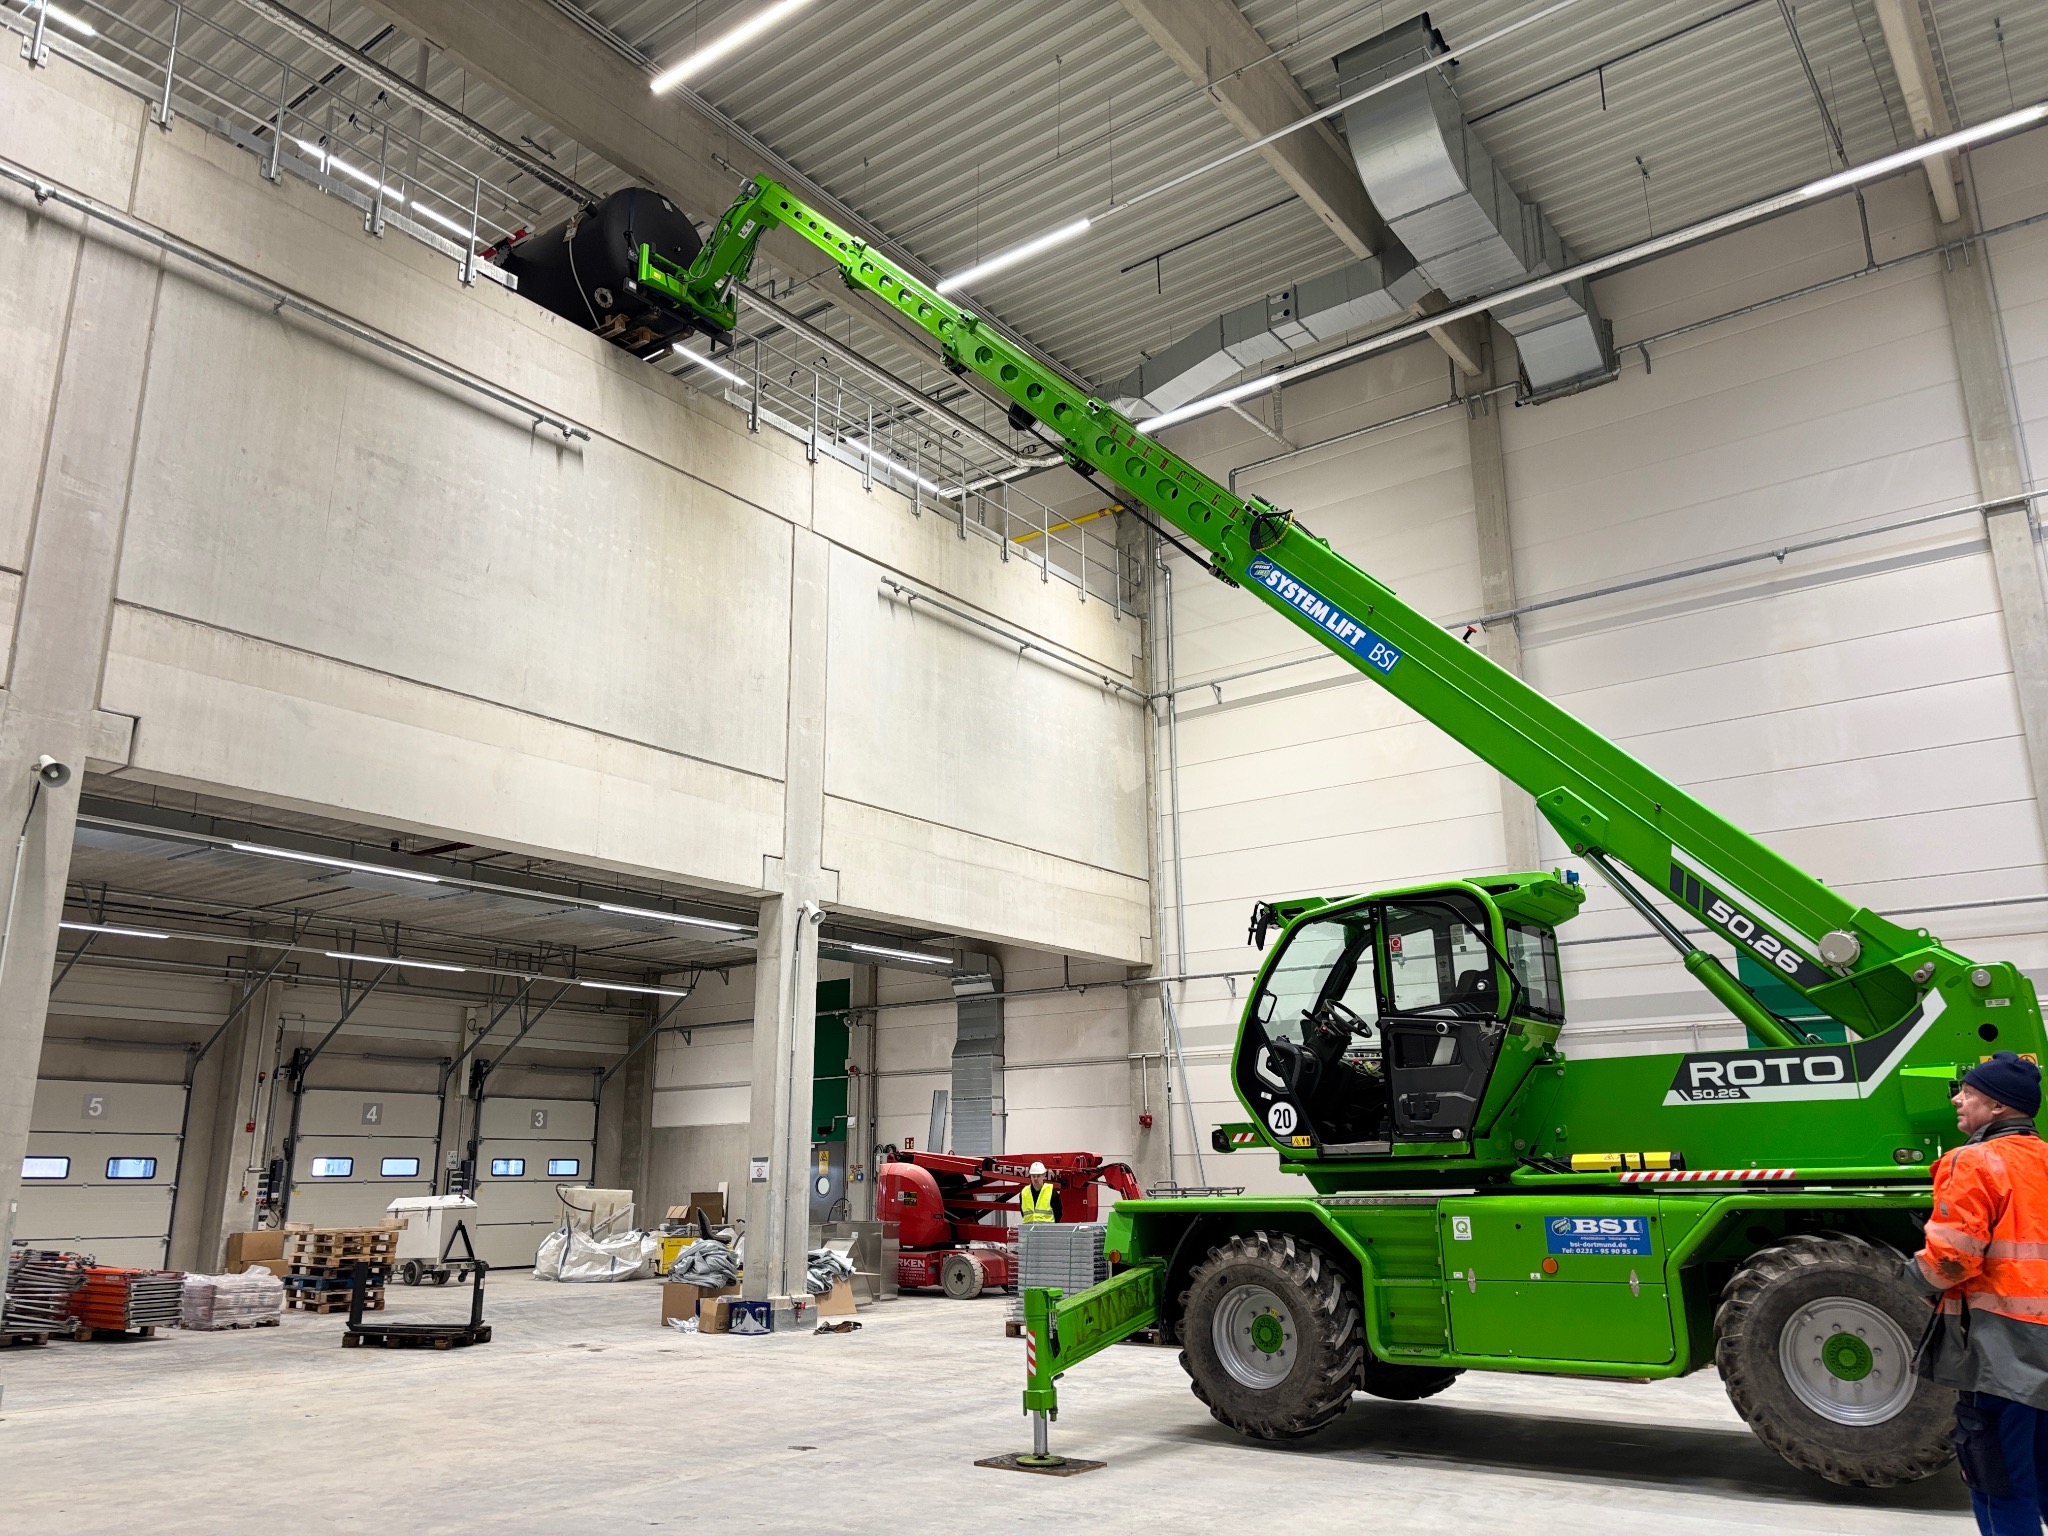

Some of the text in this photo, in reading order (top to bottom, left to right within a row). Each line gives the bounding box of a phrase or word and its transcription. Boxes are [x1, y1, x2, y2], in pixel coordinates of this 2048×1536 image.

[1265, 570, 1399, 672] SYSTEM LIFT BSI
[1706, 899, 1804, 974] 50.26
[1689, 1055, 1845, 1088] ROTO
[1692, 1088, 1741, 1100] 50.26
[88, 1097, 103, 1116] 5
[366, 1105, 377, 1122] 4
[535, 1111, 544, 1127] 3
[1273, 1108, 1292, 1129] 20
[991, 1163, 1061, 1181] GERN
[1572, 1219, 1640, 1234] BSI
[898, 1258, 926, 1268] RKEN
